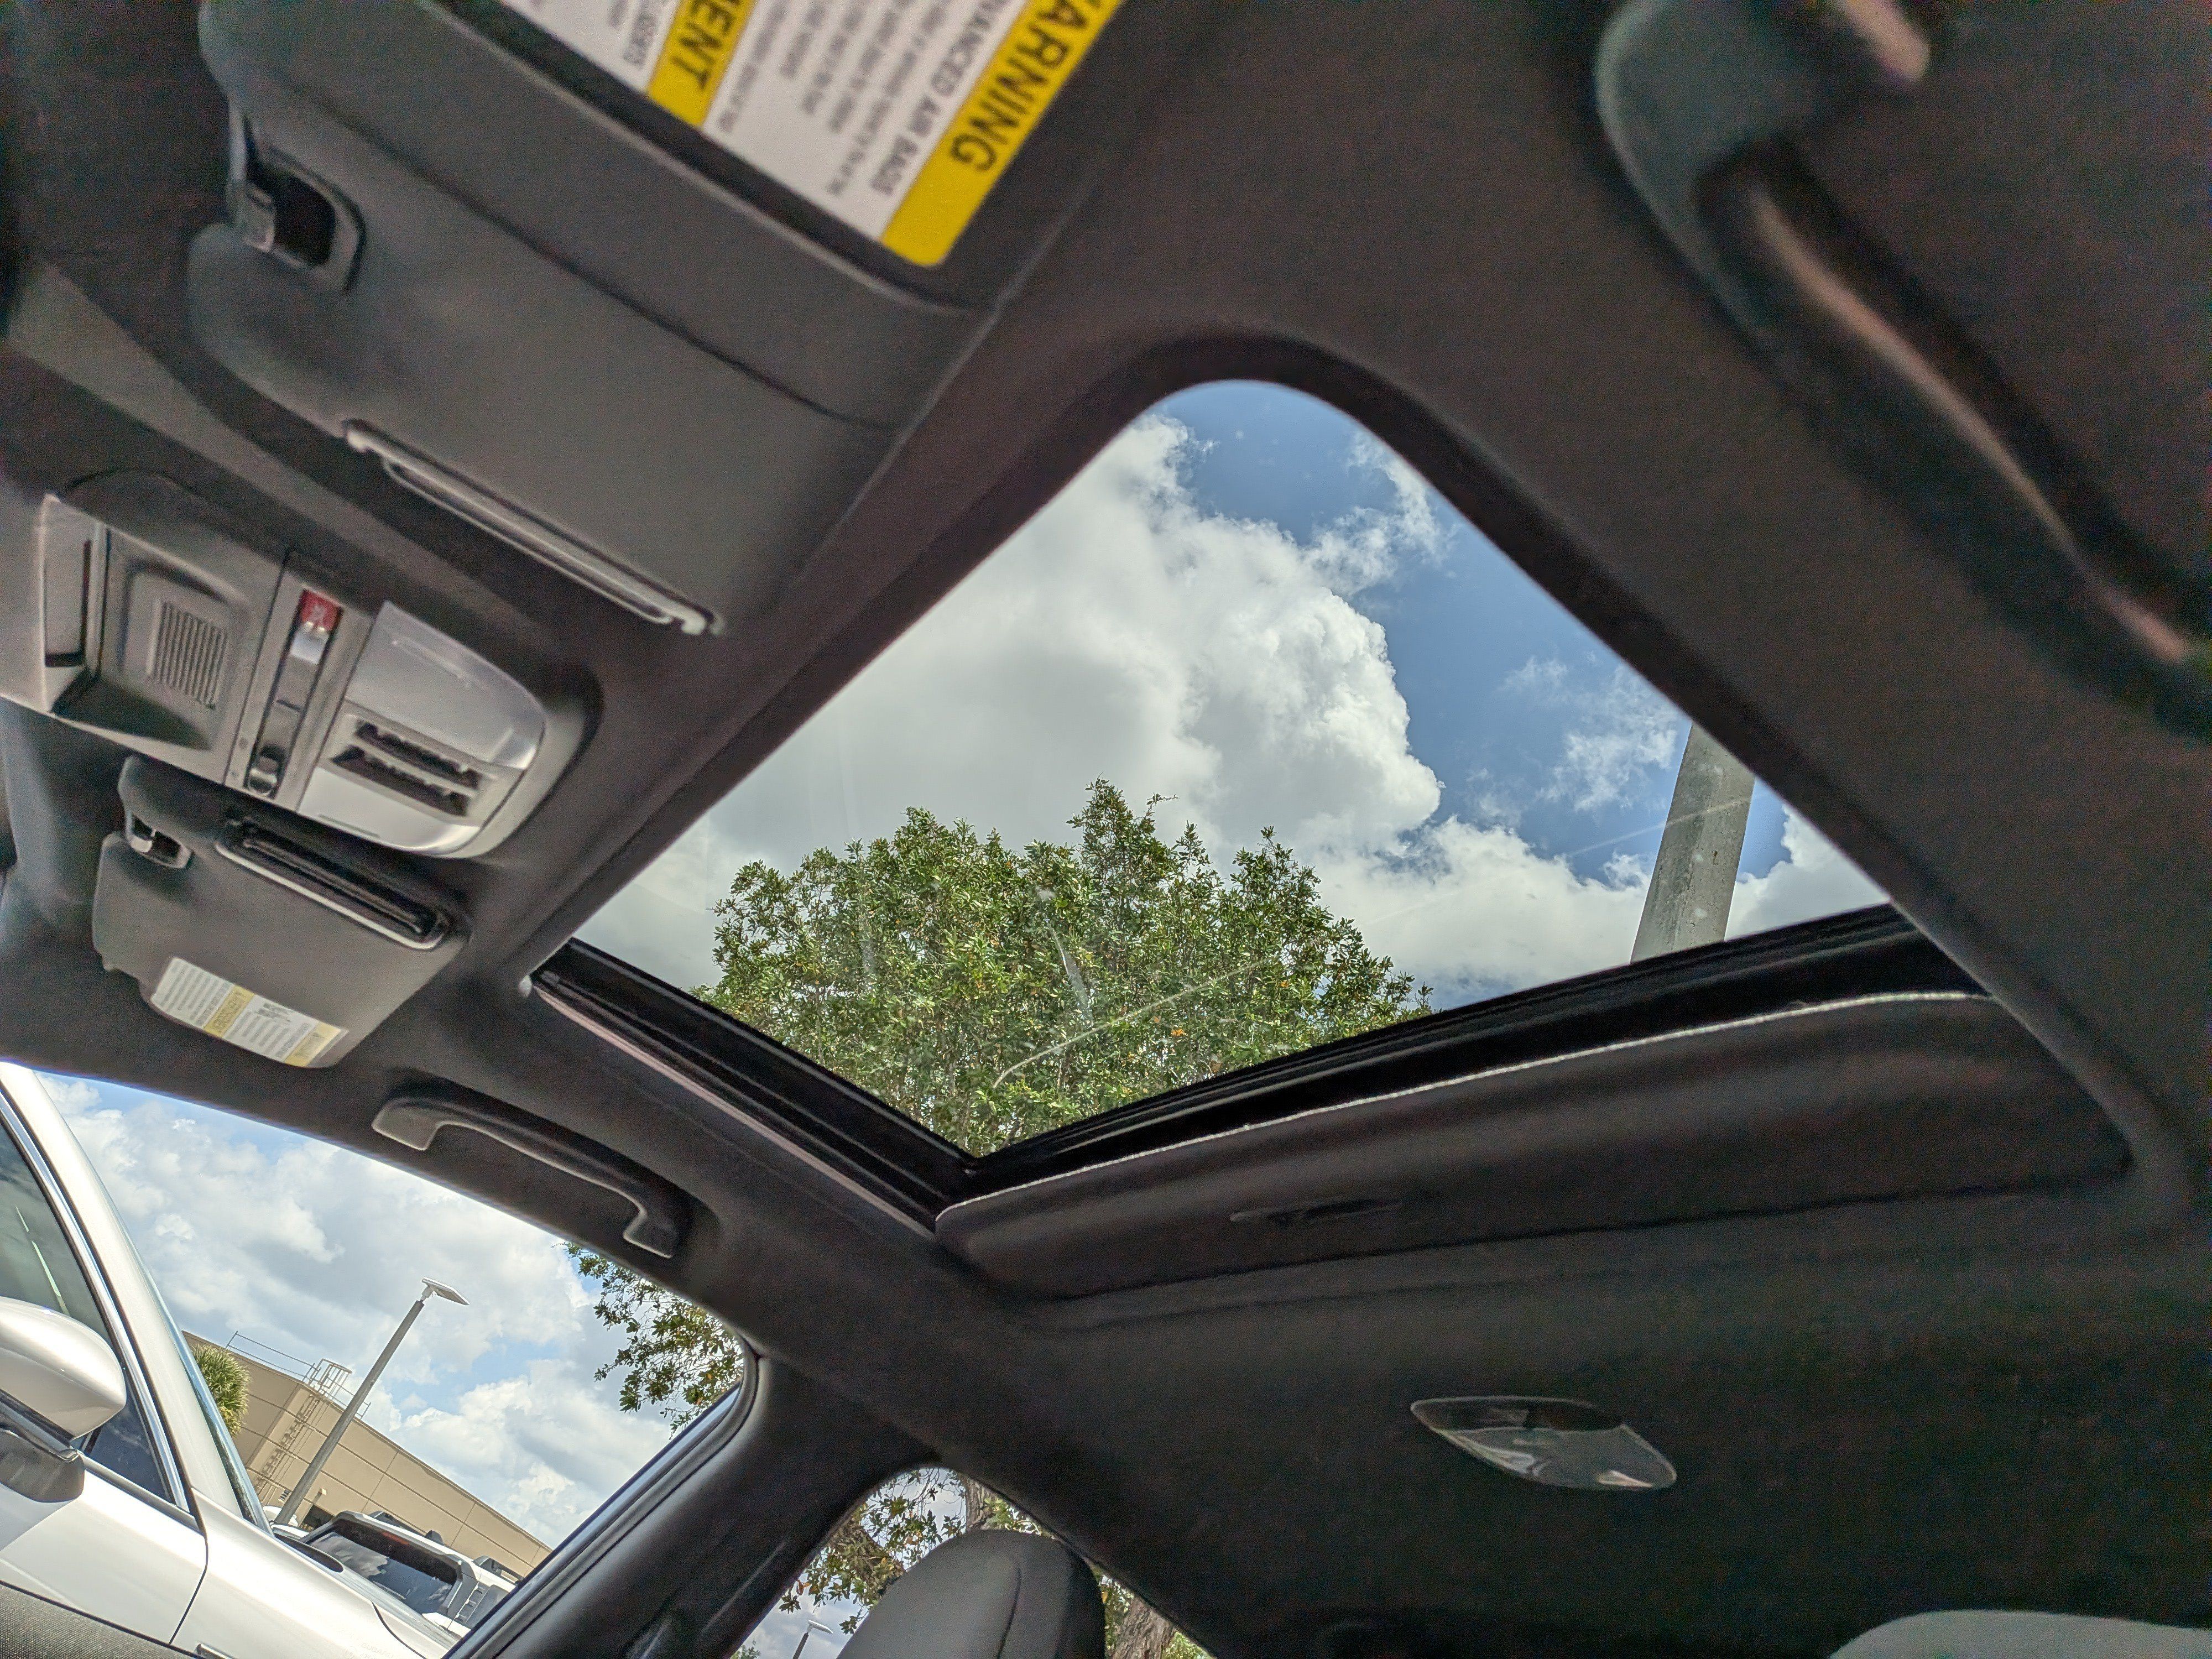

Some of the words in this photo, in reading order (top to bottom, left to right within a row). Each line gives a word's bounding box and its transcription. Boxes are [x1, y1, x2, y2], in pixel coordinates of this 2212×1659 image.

[670, 0, 738, 90] ENT
[909, 92, 941, 139] AIR
[948, 0, 1102, 173] ARNING
[869, 134, 919, 197] BAGS
